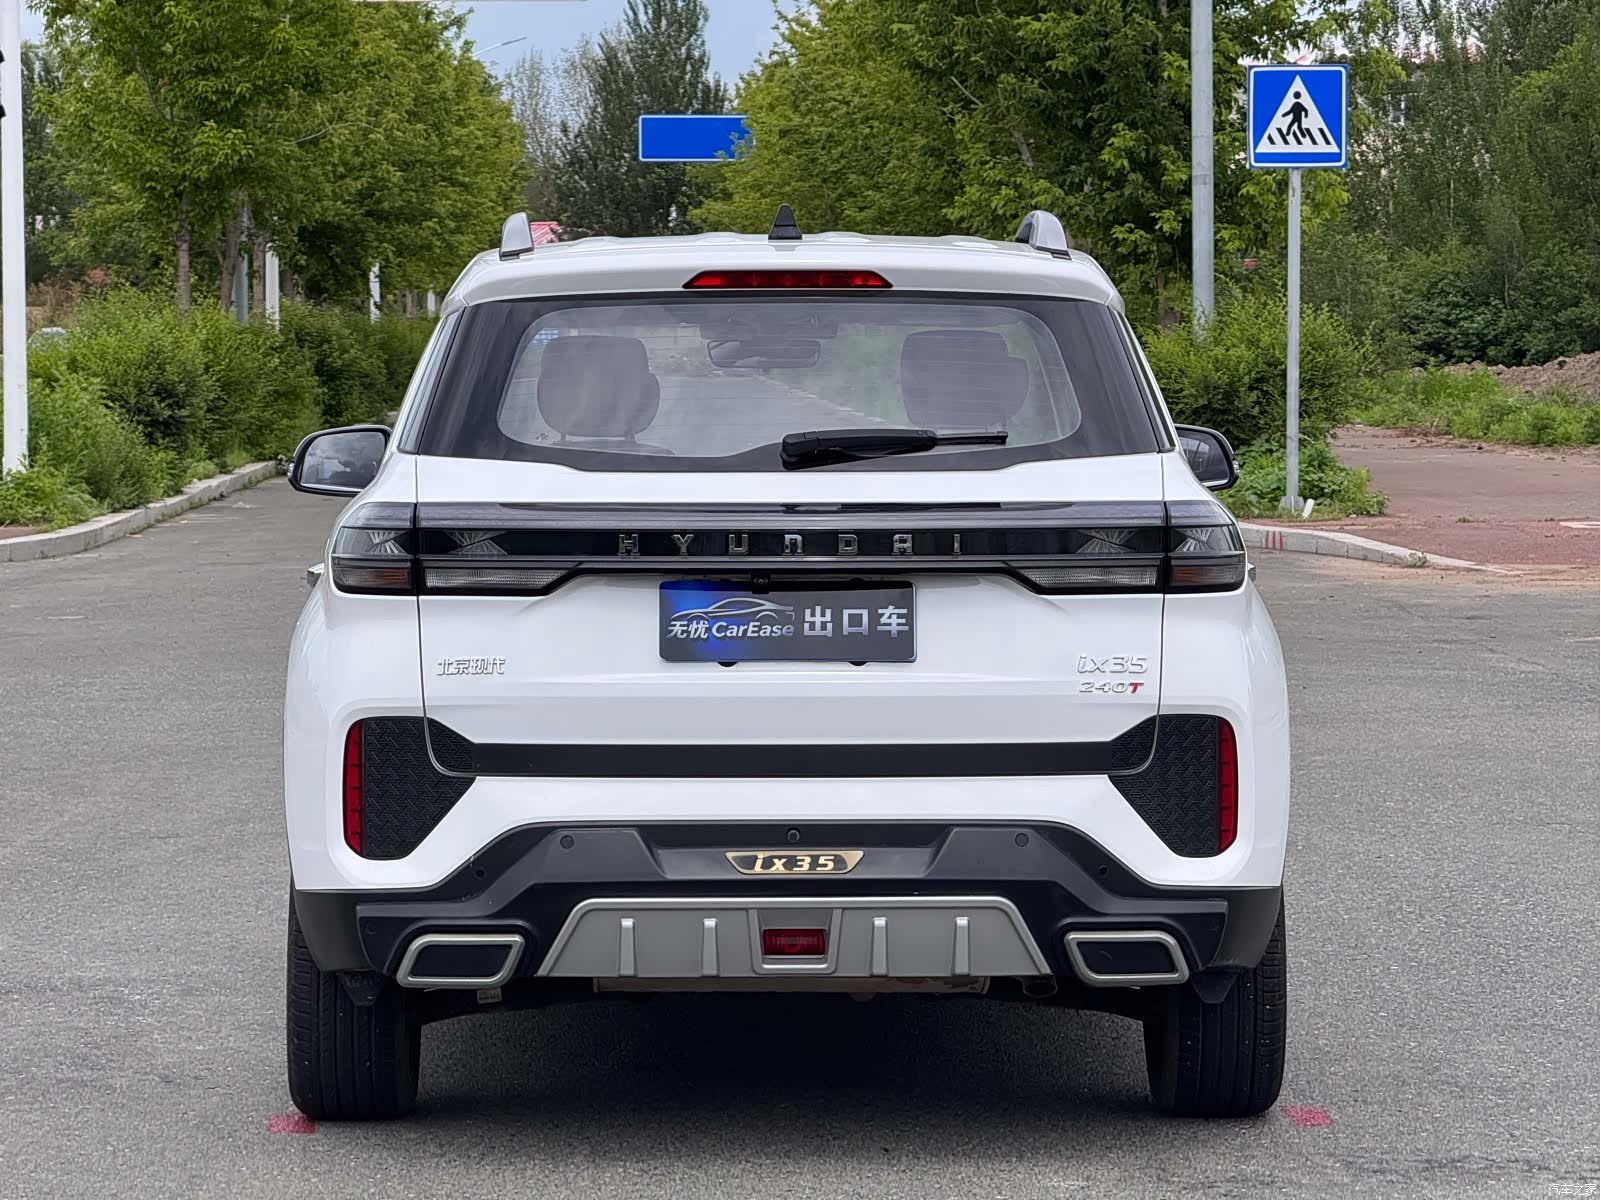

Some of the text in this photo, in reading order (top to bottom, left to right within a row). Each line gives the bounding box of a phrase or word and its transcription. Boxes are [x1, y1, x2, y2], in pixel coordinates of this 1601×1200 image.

[618, 533, 962, 555] HYUNDAI
[666, 620, 795, 639] 无忧 CarEase
[803, 605, 910, 638] 出口车
[436, 657, 506, 676] 北京现代
[1077, 654, 1148, 674] ix35
[1078, 681, 1144, 694] 240T
[754, 853, 835, 872] ix35
